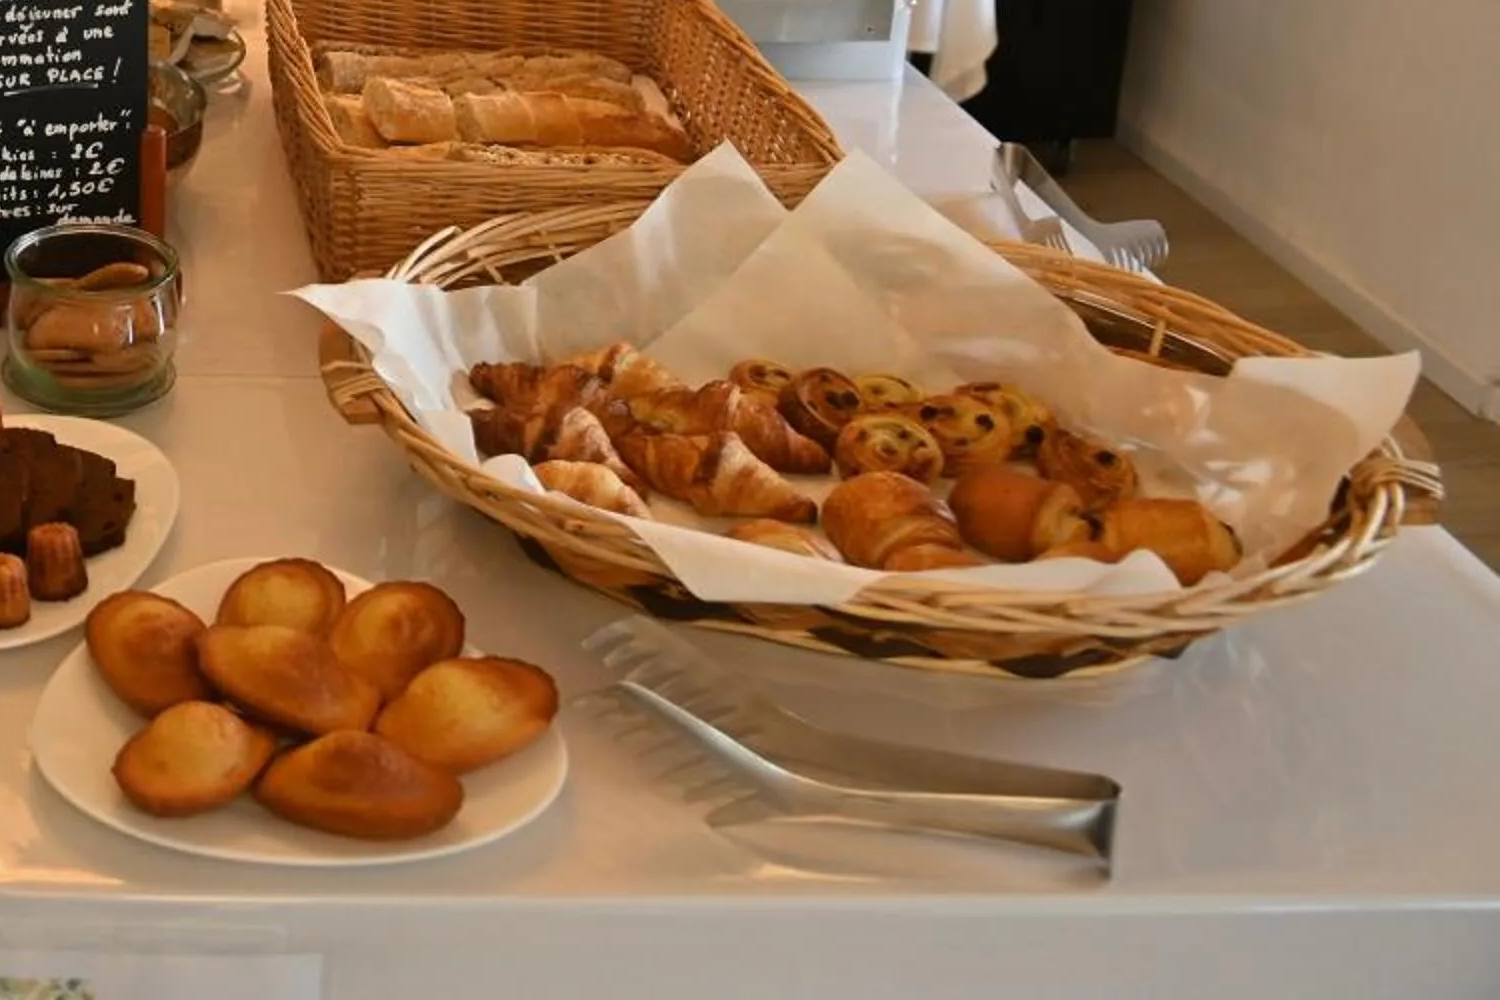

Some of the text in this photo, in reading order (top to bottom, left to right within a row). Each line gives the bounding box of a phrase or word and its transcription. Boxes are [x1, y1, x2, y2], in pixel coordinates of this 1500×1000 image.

[55, 25, 69, 43] à
[83, 24, 114, 40] une
[46, 202, 80, 215] sur
[56, 207, 137, 226] demande
